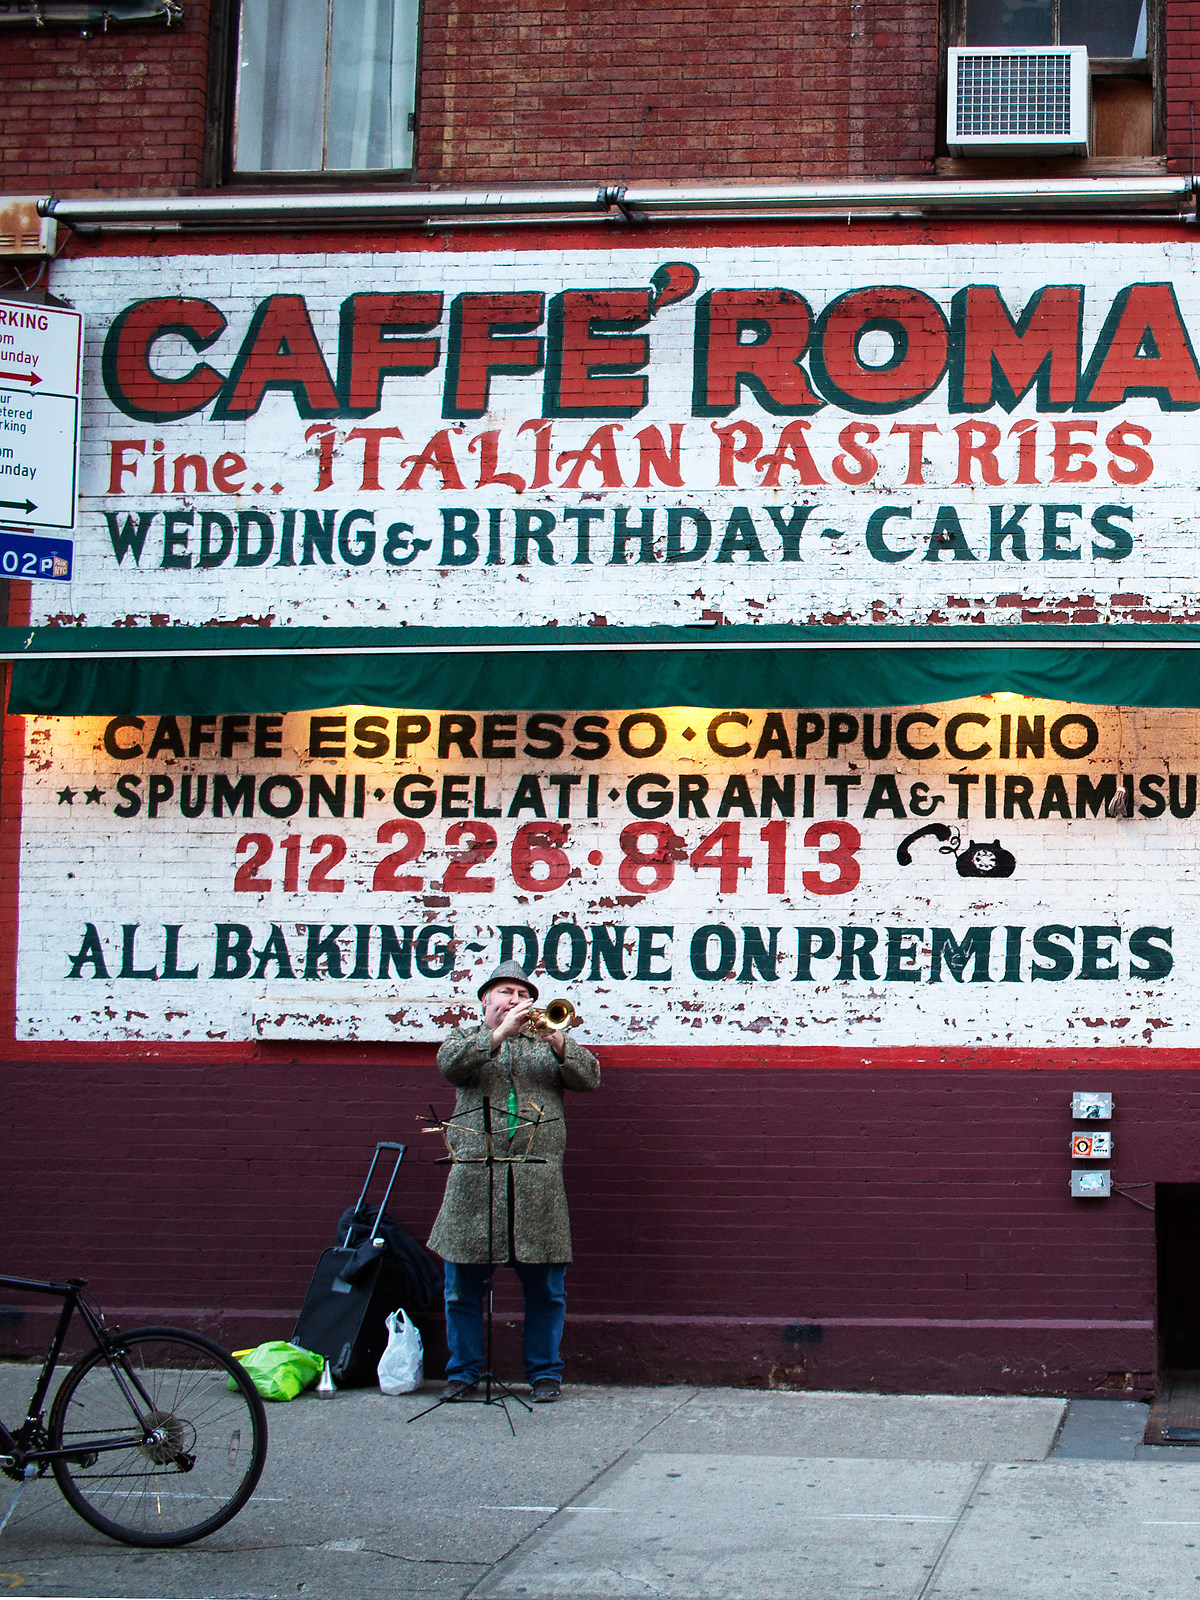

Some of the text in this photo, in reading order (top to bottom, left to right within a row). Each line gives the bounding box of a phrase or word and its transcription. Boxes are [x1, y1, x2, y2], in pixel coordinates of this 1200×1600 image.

[305, 418, 687, 493] ITALIAN
[710, 418, 1155, 488] PASTRIES
[865, 505, 1134, 563] CAKES
[706, 711, 1099, 761] CAPPUCCINO
[234, 832, 347, 893] 212
[65, 922, 198, 980] ALL
[689, 924, 783, 982] ON
[790, 924, 1174, 984] PREMISES
